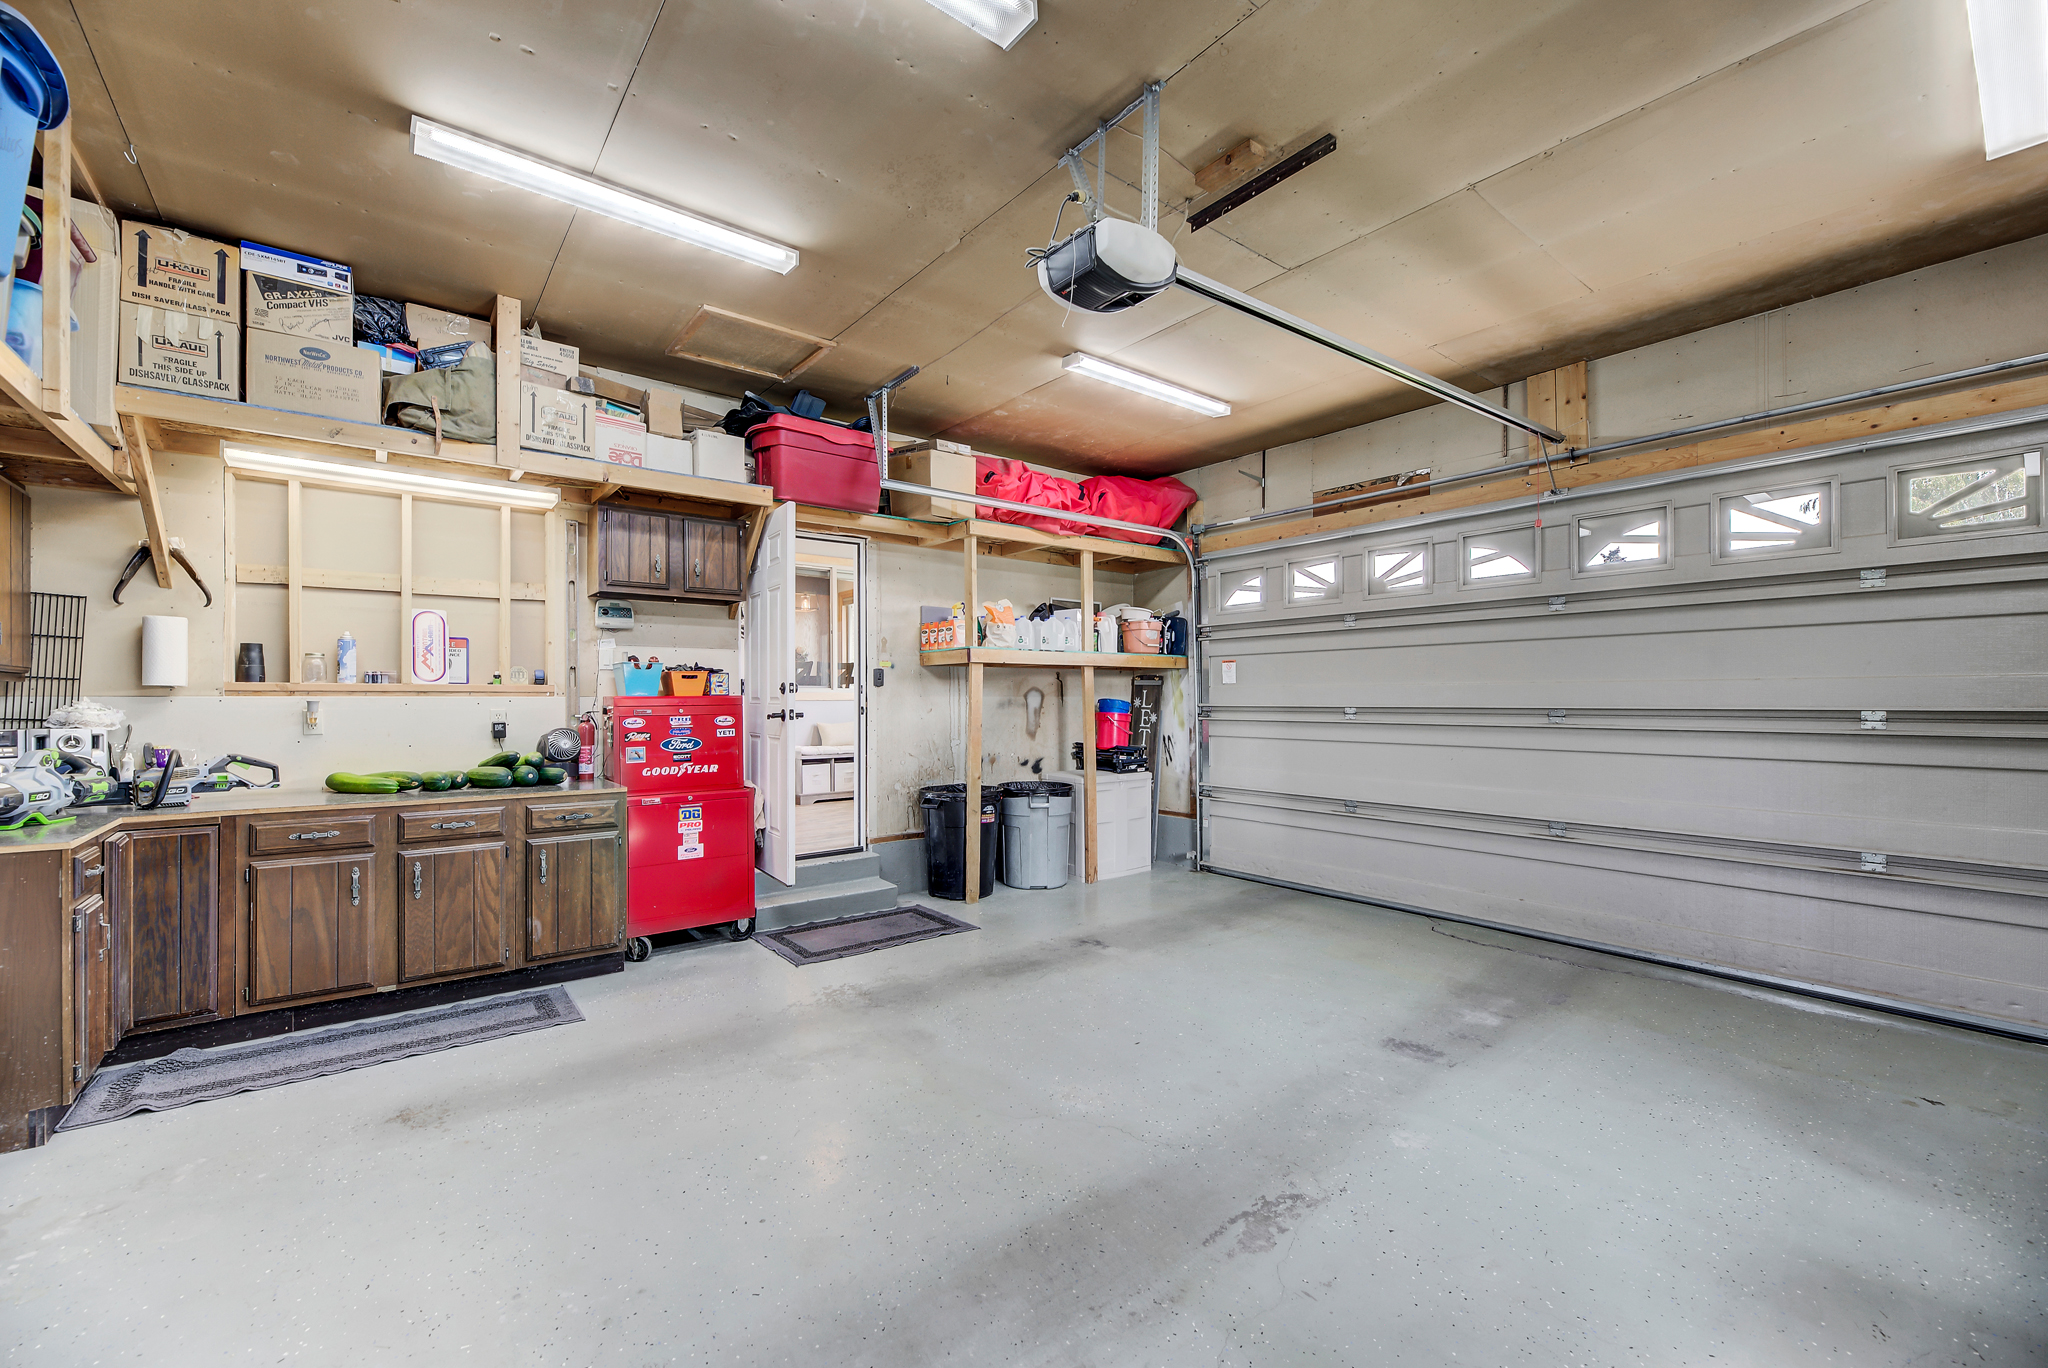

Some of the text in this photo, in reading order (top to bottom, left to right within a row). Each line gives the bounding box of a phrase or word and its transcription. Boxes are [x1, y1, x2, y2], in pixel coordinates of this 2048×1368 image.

[157, 259, 208, 277] U-HAUL
[168, 276, 197, 288] FRAGILE
[148, 279, 216, 299] HANDLE WITH CARE
[131, 291, 231, 317] DISH SAVER/GLASS PACK
[266, 300, 307, 310] Compact
[308, 298, 329, 308] VHS
[332, 334, 351, 343] JVC
[163, 356, 198, 368] FRAGILE
[264, 353, 301, 366] NORTHWEST
[323, 363, 354, 375] PRODUCTS
[536, 361, 557, 371] Spring
[152, 362, 208, 378] THIS SIDE UP
[129, 367, 230, 392] DISHSAVER/GLASSPACK
[608, 451, 643, 468] Dole
[668, 738, 695, 750] Ford
[641, 762, 719, 777] GOODYEAR
[30, 792, 50, 802] EGO
[681, 808, 701, 820] DG
[679, 821, 702, 829] PRO
